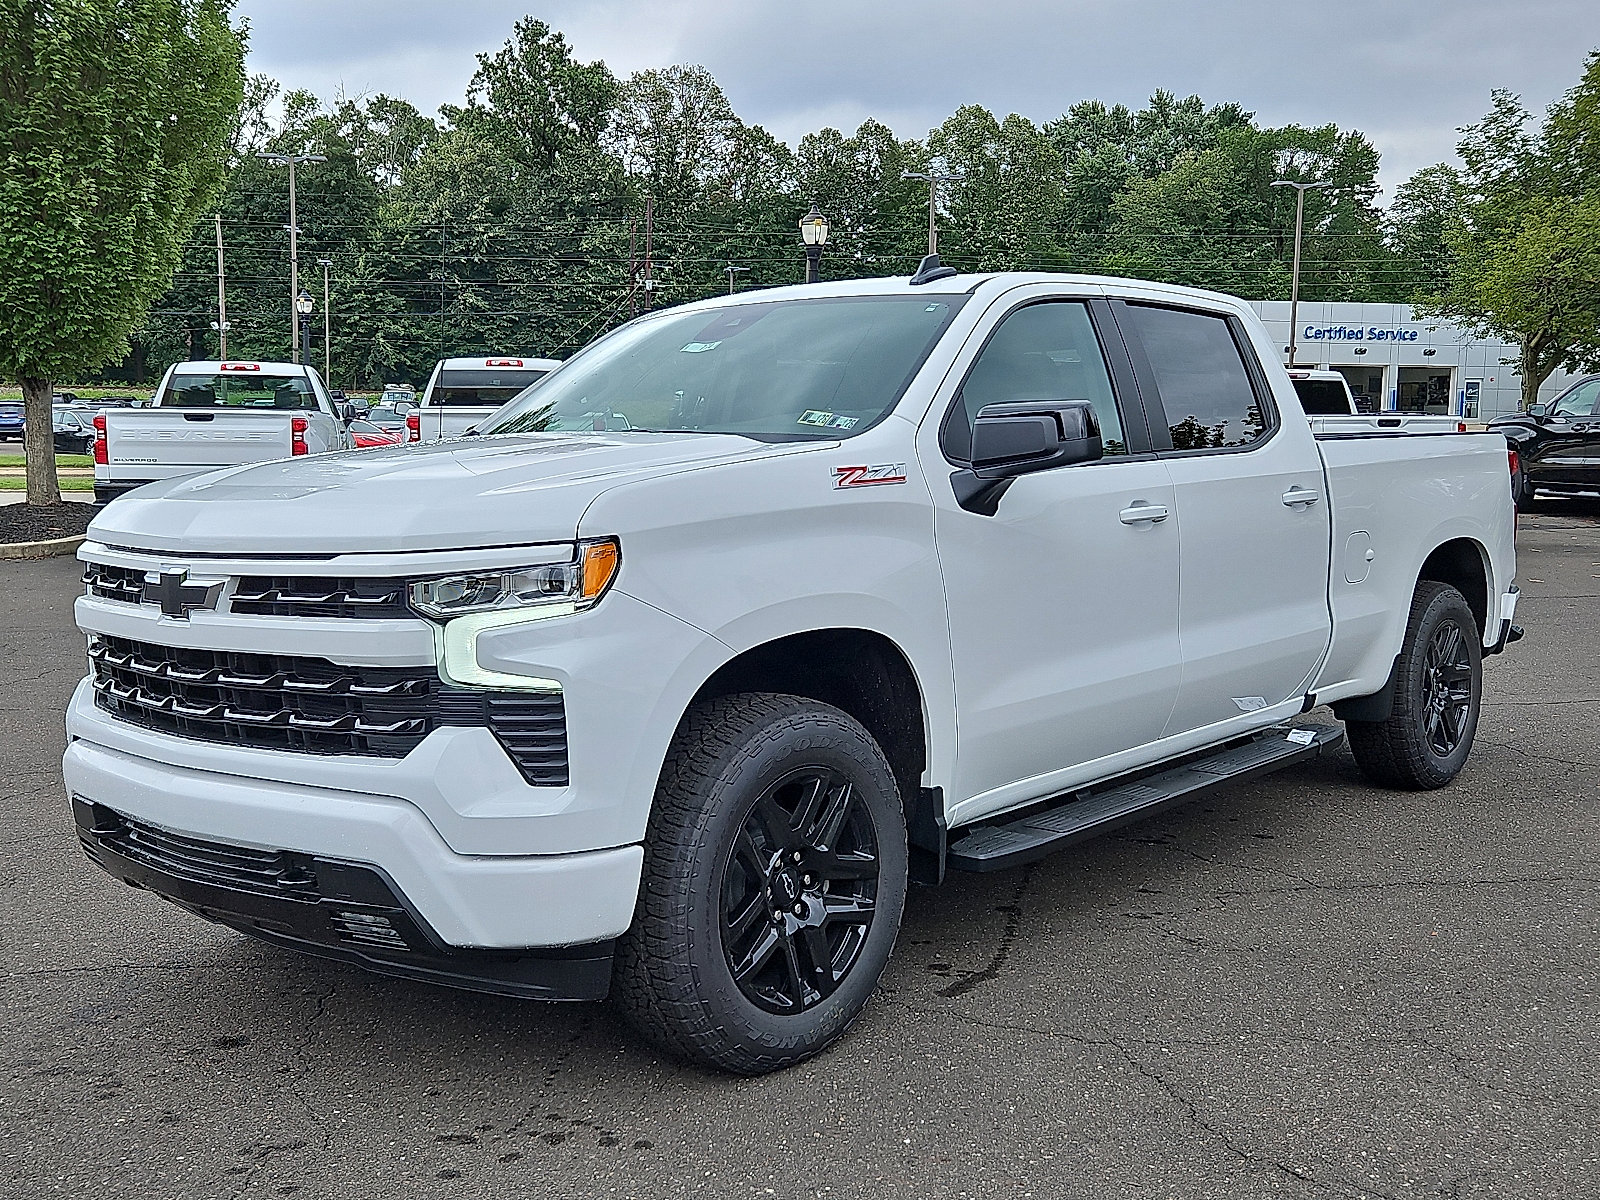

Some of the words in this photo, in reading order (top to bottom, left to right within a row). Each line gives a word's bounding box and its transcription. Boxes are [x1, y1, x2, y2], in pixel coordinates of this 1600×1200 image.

[1304, 325, 1364, 340] Certified
[1367, 327, 1418, 341] Service
[119, 429, 279, 441] CHEVROLET
[830, 462, 907, 490] Z71
[757, 735, 893, 808] GOODYEAR
